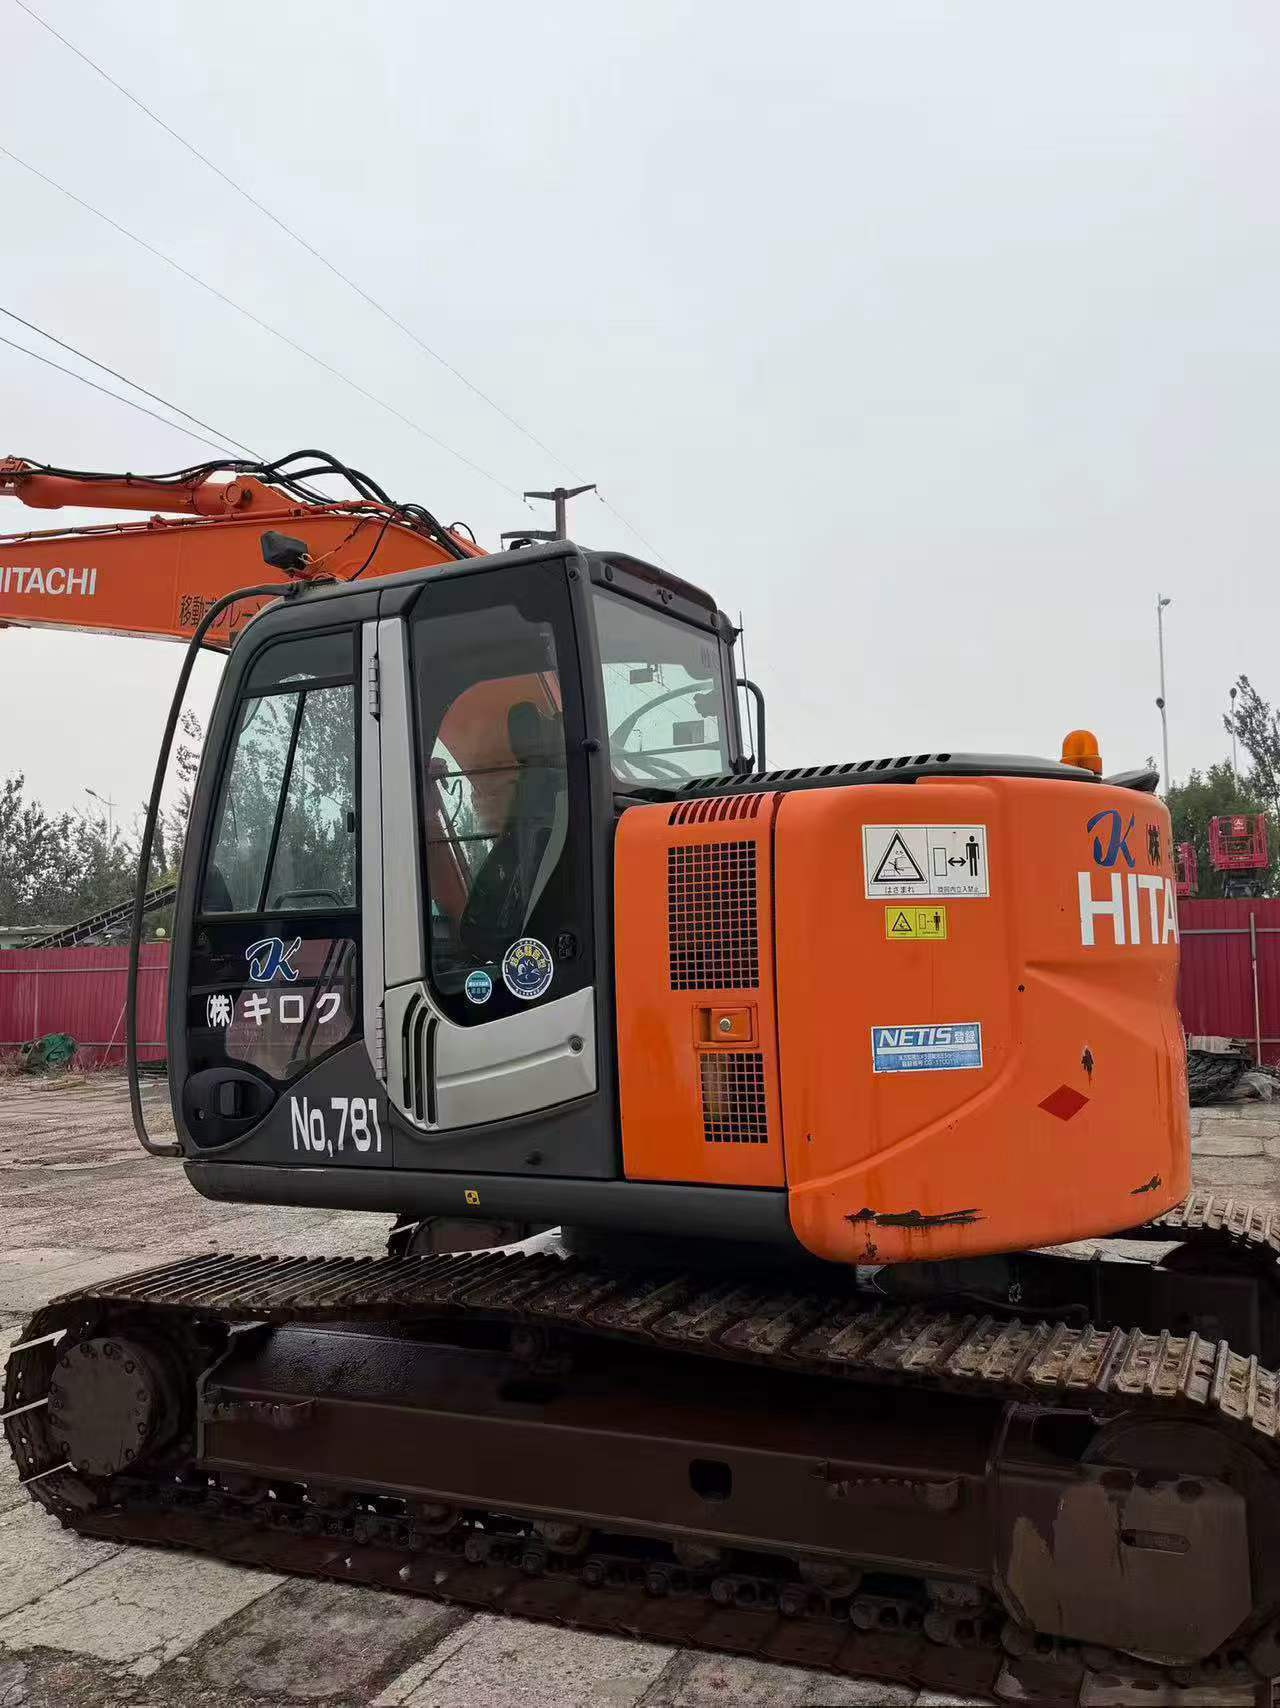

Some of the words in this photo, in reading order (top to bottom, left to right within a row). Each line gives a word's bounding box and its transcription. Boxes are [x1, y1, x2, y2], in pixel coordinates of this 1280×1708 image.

[0, 567, 97, 595] ITACHI
[1077, 871, 1180, 946] HITA
[879, 1027, 953, 1047] NETIS
